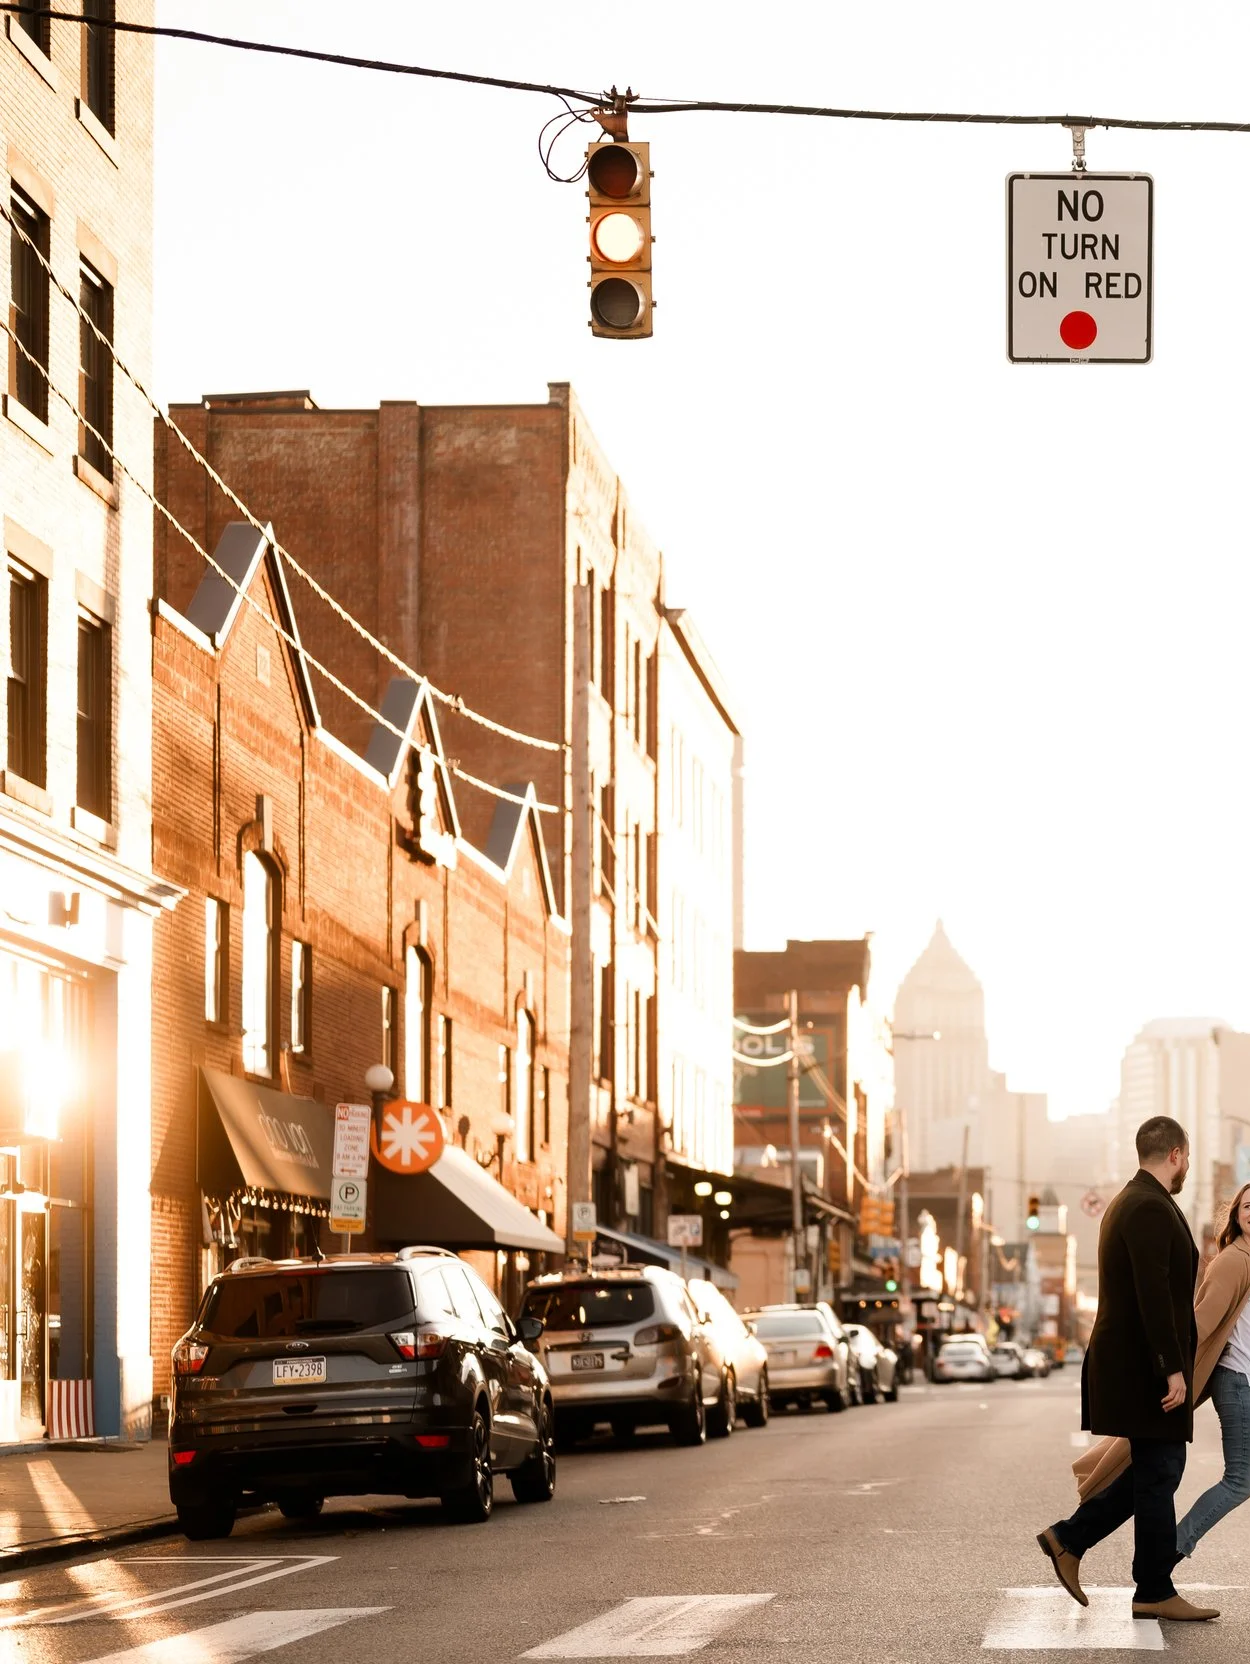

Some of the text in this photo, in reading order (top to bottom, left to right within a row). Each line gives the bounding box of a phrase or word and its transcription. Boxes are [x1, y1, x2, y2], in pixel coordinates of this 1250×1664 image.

[1057, 189, 1104, 222] NO
[1042, 233, 1119, 260] TURN
[1018, 271, 1142, 299] ON RED
[337, 1107, 349, 1119] NO
[345, 1186, 355, 1199] P
